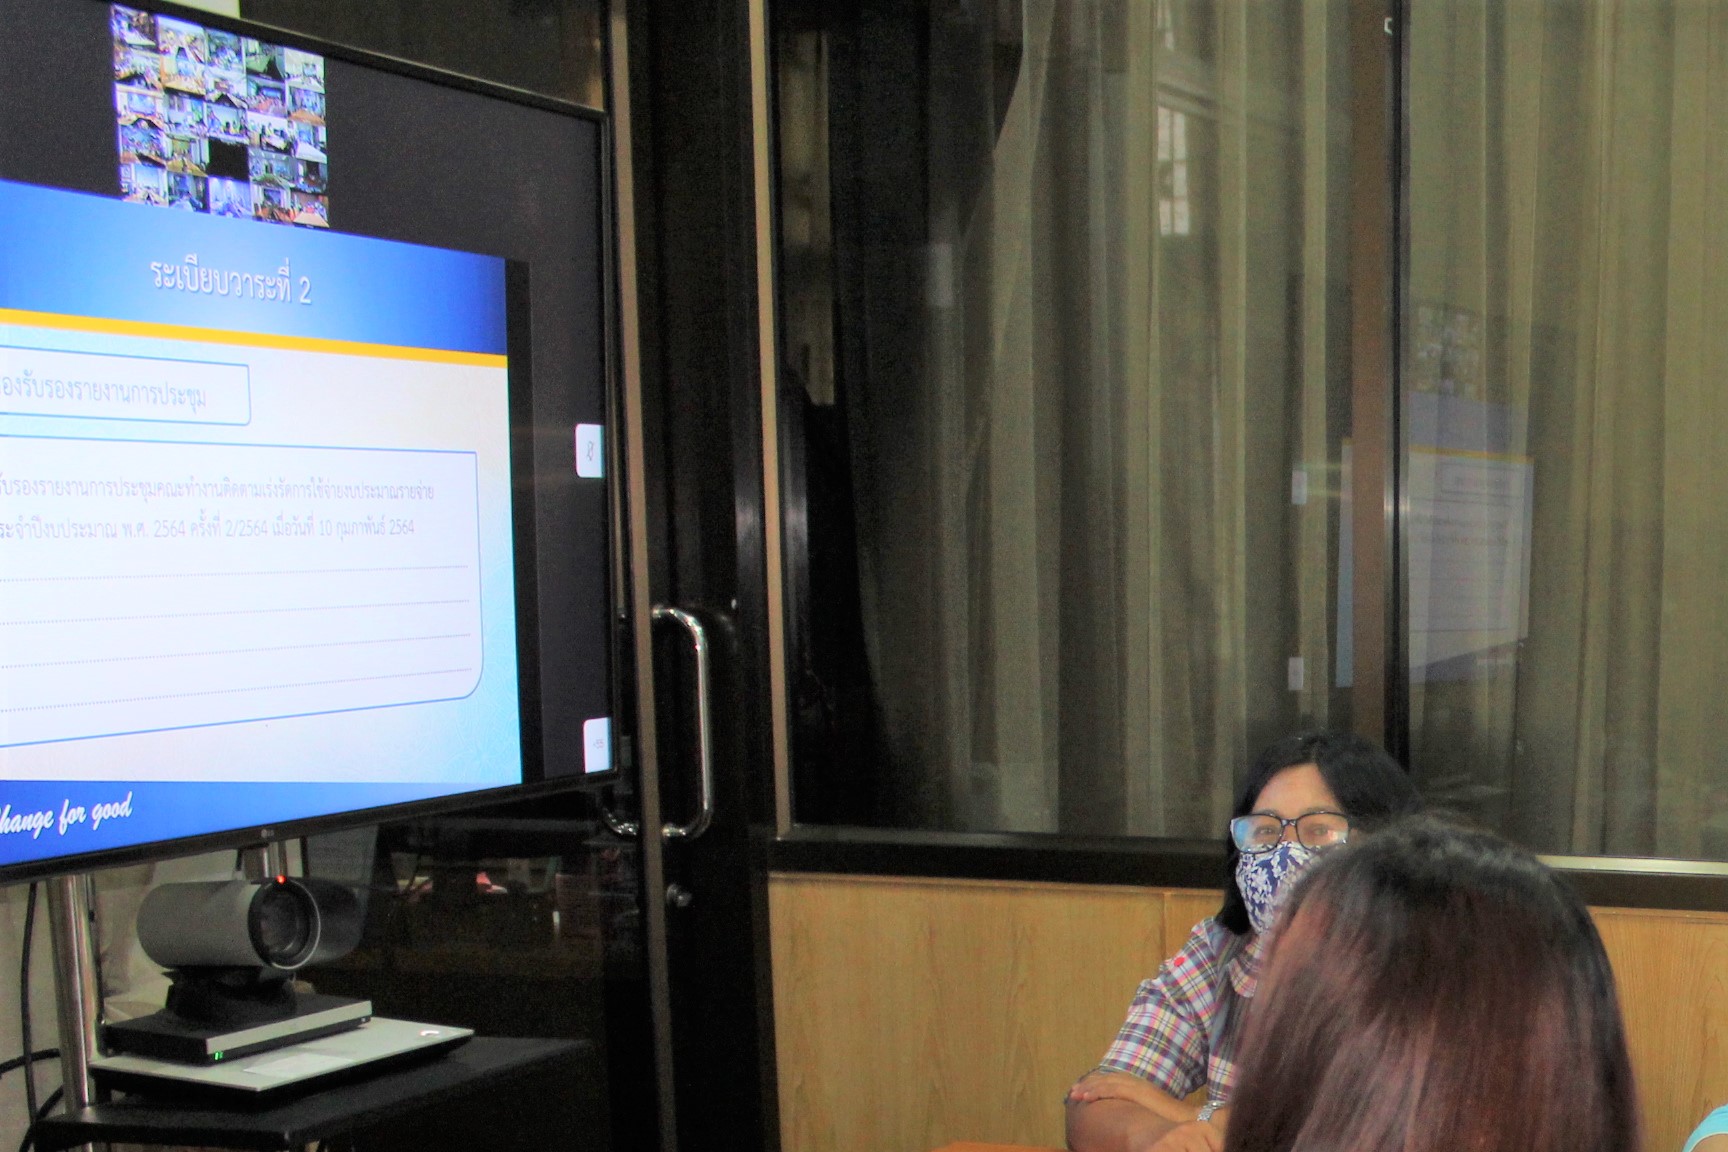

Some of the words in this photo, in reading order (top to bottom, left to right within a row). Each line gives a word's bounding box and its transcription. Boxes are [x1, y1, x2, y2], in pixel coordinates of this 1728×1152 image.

[150, 253, 292, 303] ระเบียบวาระที่
[299, 275, 312, 305] 2
[0, 369, 207, 415] องรับรองรายงานการประชุม
[121, 521, 149, 539] พ.ศ.
[153, 519, 186, 538] 2564
[190, 508, 222, 538] ครั้งที่
[225, 519, 268, 538] 2/2564
[318, 519, 333, 537] 10
[336, 513, 386, 542] กุมภาพันธ์
[388, 519, 415, 537] 2564
[0, 804, 55, 840] hange
[58, 798, 87, 836] for
[91, 790, 134, 831] good
